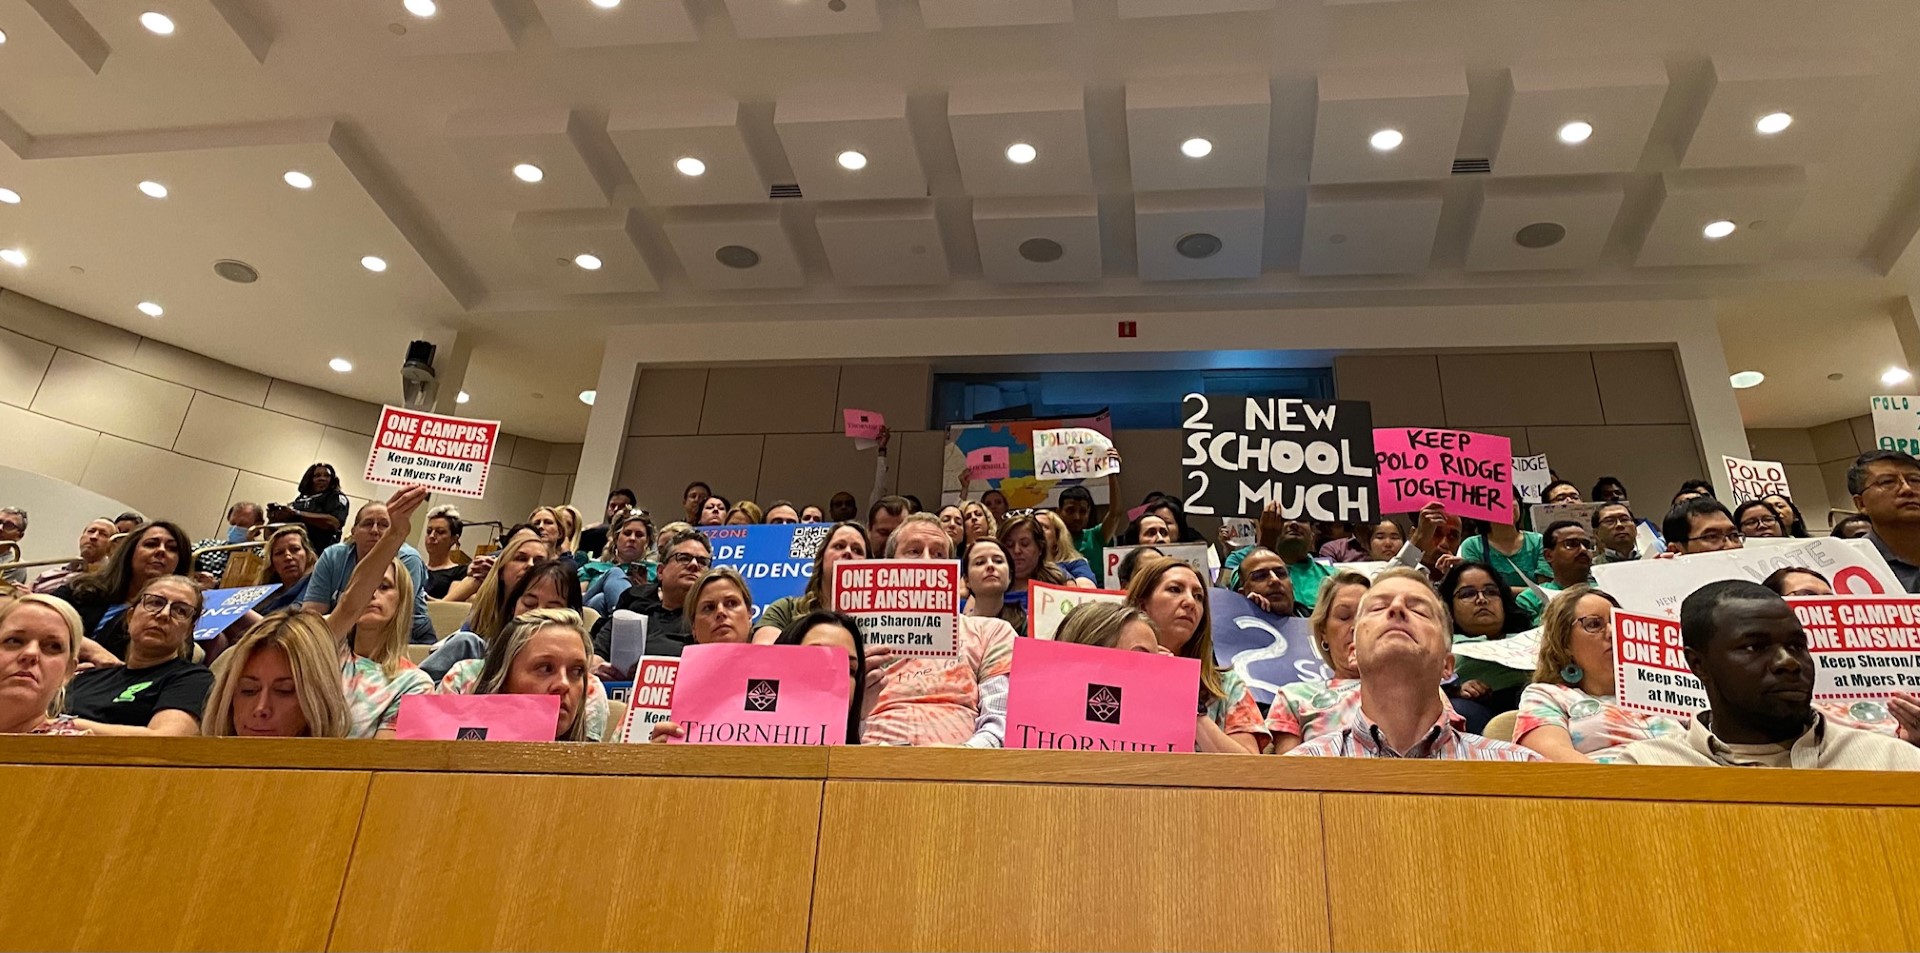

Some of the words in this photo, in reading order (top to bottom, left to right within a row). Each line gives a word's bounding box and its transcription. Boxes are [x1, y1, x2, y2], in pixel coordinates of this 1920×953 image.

[1183, 393, 1213, 429] 2
[1245, 397, 1336, 431] NEW
[1873, 397, 1908, 410] POLO
[387, 414, 419, 434] ONE
[420, 420, 489, 444] CAMPUS,
[381, 431, 412, 450] ONE
[413, 436, 489, 460] ANSWER!
[1407, 430, 1471, 451] KEEP
[387, 451, 414, 466] Keep
[416, 456, 473, 474] Sharon/AG
[1067, 446, 1080, 459] 2
[1182, 432, 1373, 477] SCHOOL
[391, 467, 402, 477] at
[403, 468, 436, 482] Myers
[438, 473, 462, 485] Park
[1040, 457, 1091, 475] ARDREY
[1376, 452, 1429, 475] POLO
[1440, 453, 1507, 483] RIDGE
[1726, 459, 1781, 481] POLO
[1183, 470, 1214, 514] 2
[1238, 479, 1369, 522] MUCH
[1388, 477, 1507, 511] TOGETHER
[841, 570, 873, 588] ONE
[877, 568, 953, 590] CAMPUS,
[840, 590, 871, 610] ONE
[874, 590, 953, 611] ANSWER!
[1656, 595, 1677, 607] NEW
[880, 615, 942, 628] Sharon/AG
[1794, 606, 1837, 626] ONE
[870, 632, 904, 645] Myers
[908, 632, 933, 645] Park
[1622, 619, 1660, 644] ONE
[1843, 627, 1920, 649] ANSWE
[1622, 641, 1661, 666] ONE
[1820, 656, 1856, 669] Keep
[643, 665, 677, 685] ONE
[1638, 668, 1671, 685] Keep
[1834, 676, 1849, 687] at
[1851, 674, 1896, 688] Myers
[638, 686, 671, 706] ONE
[1648, 689, 1662, 701] at
[1664, 690, 1707, 709] Myers
[680, 720, 836, 745] THORNHILL
